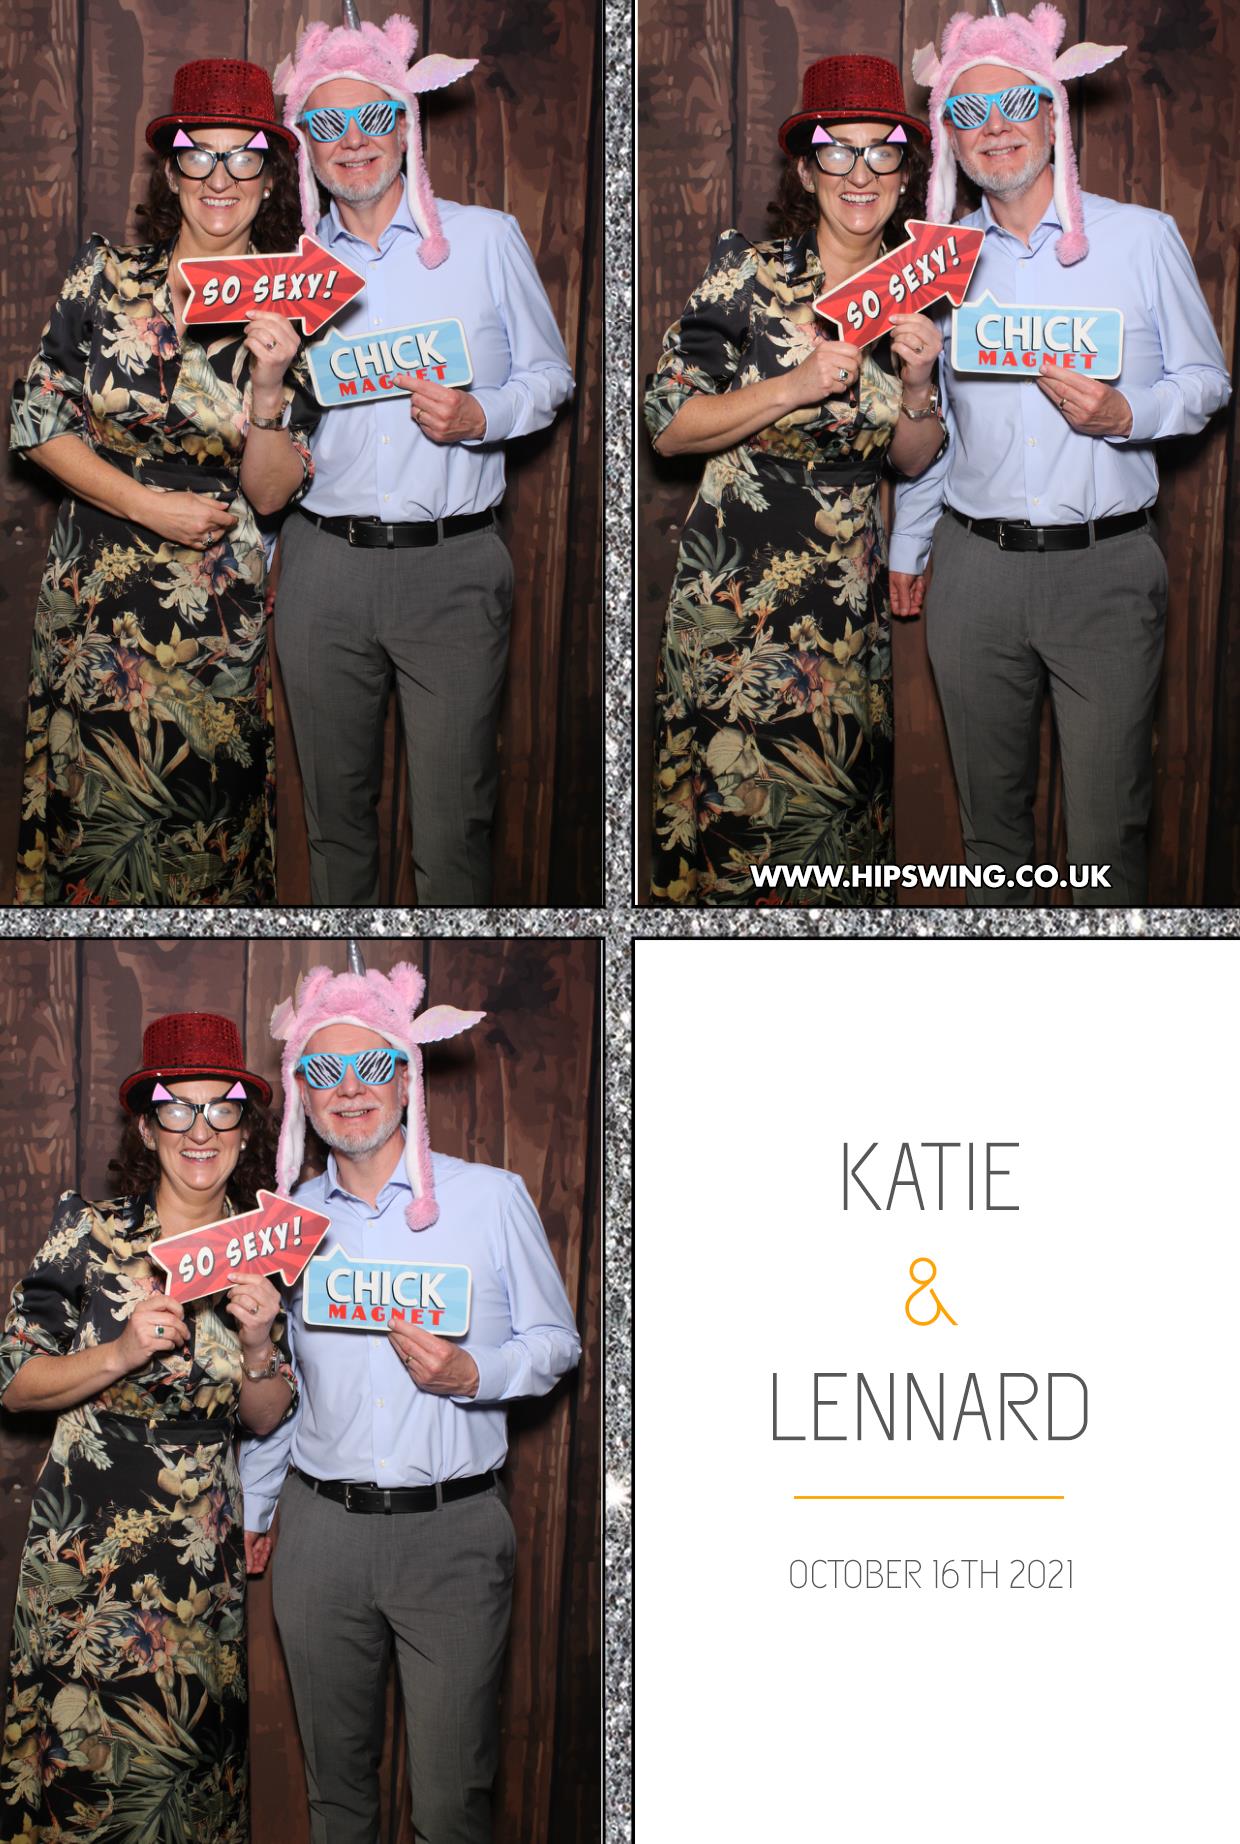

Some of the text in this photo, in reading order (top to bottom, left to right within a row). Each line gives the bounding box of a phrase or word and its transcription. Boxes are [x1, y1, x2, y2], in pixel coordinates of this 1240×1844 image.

[202, 270, 338, 306] SO SEXY!
[845, 235, 962, 331] SO SEXY!
[975, 313, 1099, 353] CHICK
[329, 328, 448, 382] CHICK
[978, 350, 1097, 370] MAGNET
[338, 364, 448, 397] MAGET
[178, 1215, 302, 1283] SO SEXY!
[325, 1267, 448, 1310] CHICK
[328, 1303, 445, 1326] MAGNET
